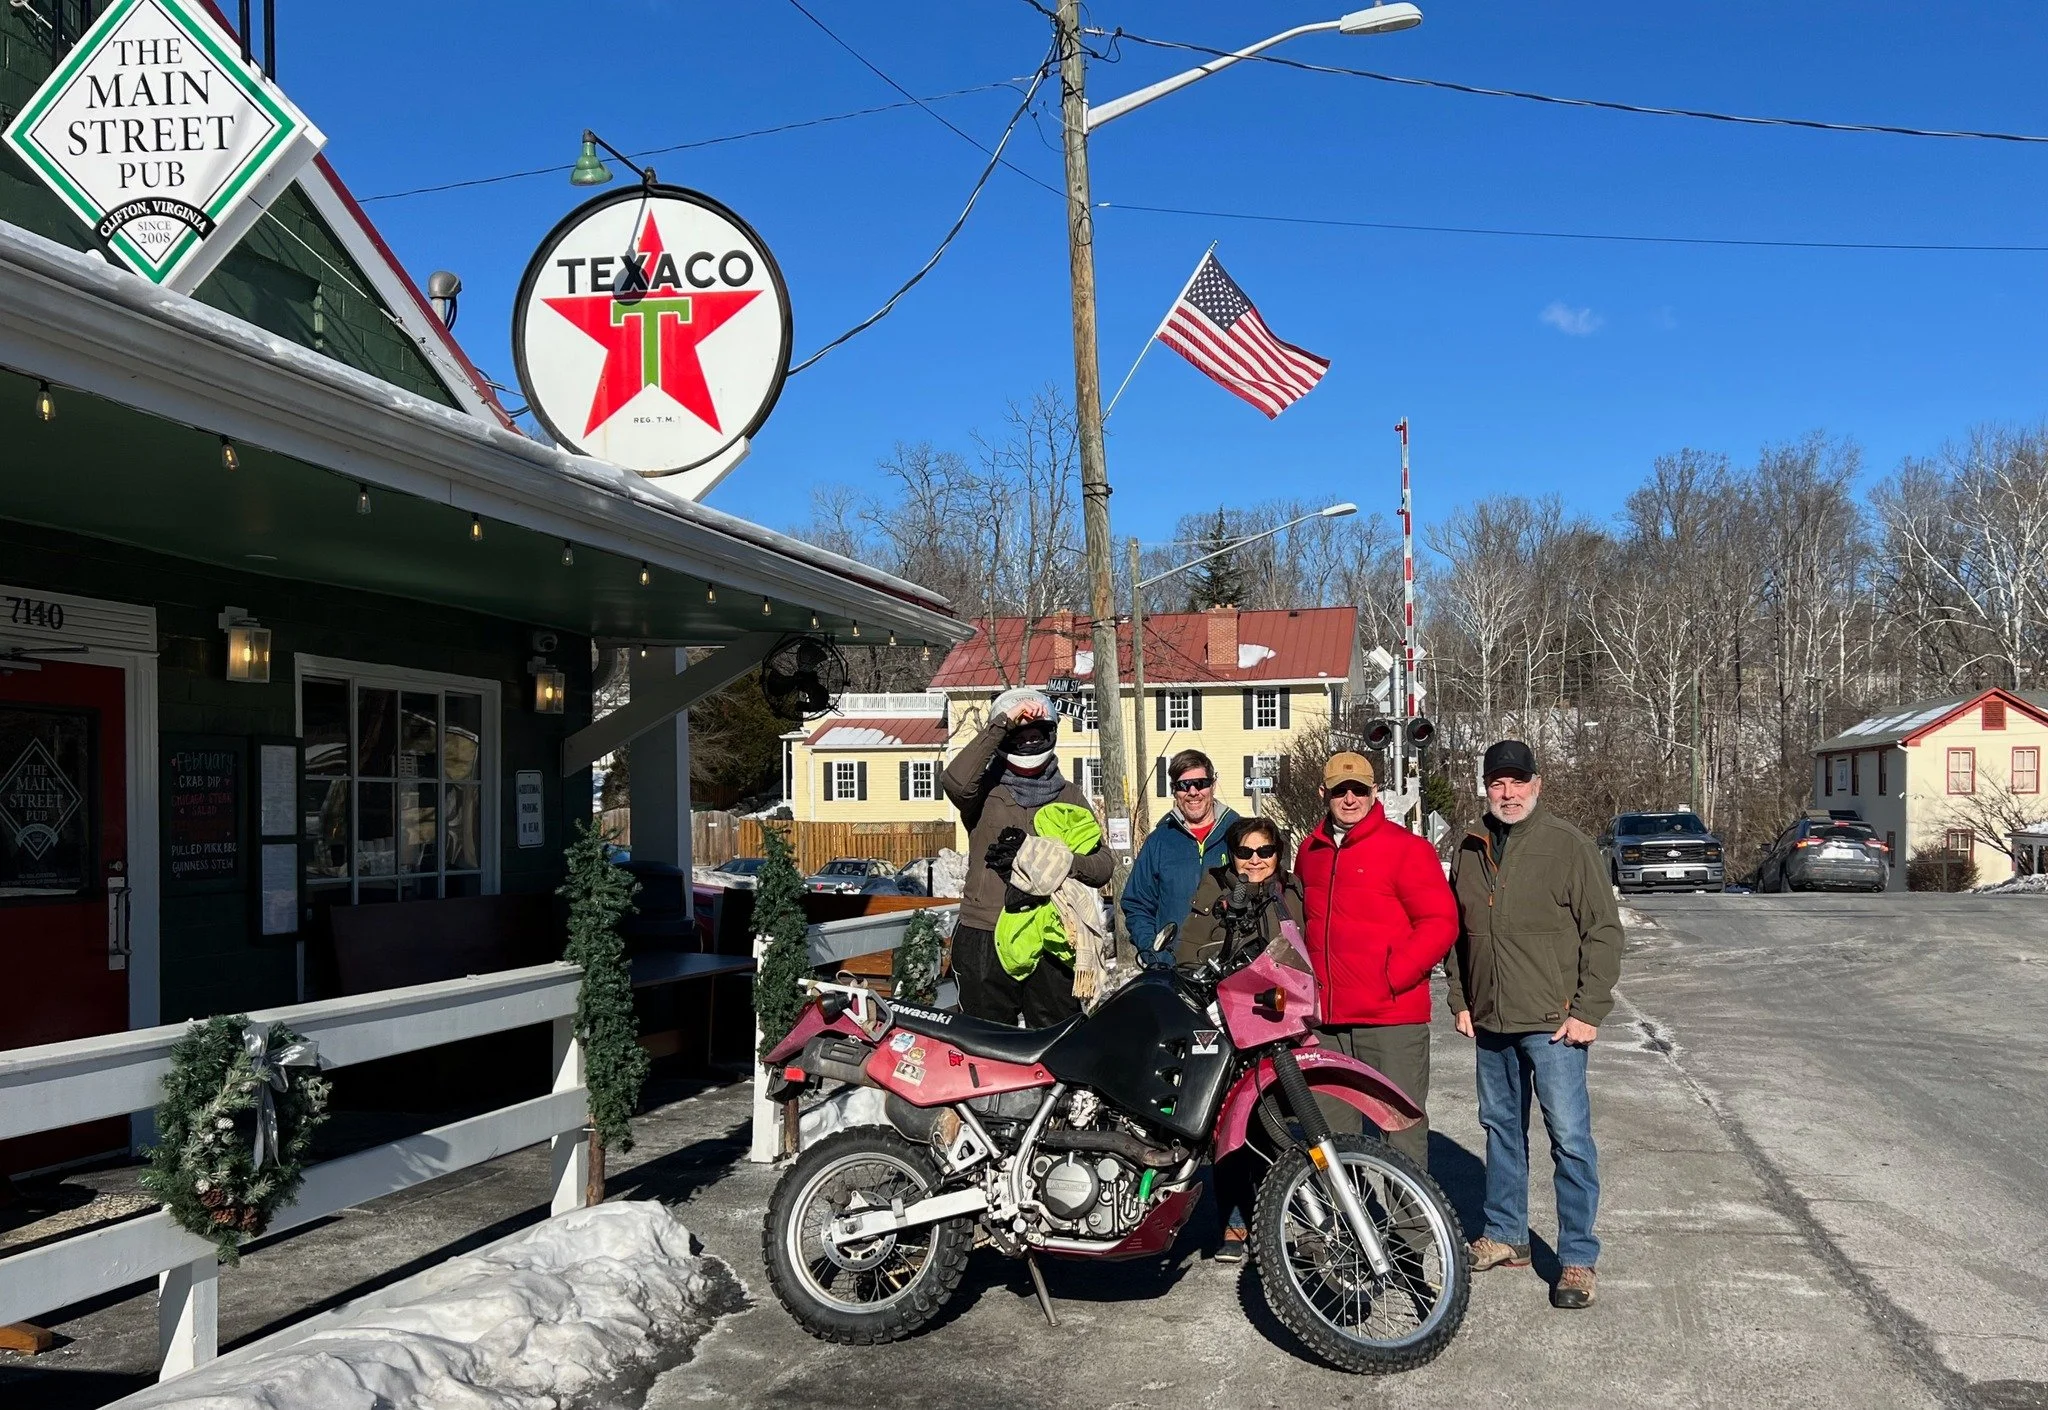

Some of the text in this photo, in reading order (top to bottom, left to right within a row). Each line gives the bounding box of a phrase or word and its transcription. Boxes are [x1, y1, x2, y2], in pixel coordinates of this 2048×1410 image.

[113, 37, 183, 66] THE
[86, 70, 213, 109] MAIN
[67, 115, 235, 156] STREET
[118, 160, 185, 189] PUB
[100, 201, 206, 237] CLIFTON, VIRGINIA
[138, 220, 171, 231] SINCE
[140, 232, 171, 244] 2008
[557, 250, 754, 294] TEXACO
[6, 597, 64, 630] 7140
[1049, 679, 1078, 691] MAIN ST
[1066, 703, 1081, 717] LN
[26, 764, 48, 776] THE
[177, 752, 233, 775] February
[15, 777, 56, 791] MAIN
[179, 775, 221, 788] CRAB DIP
[9, 793, 63, 808] STREET
[26, 810, 48, 821] PUB
[171, 844, 202, 857] PULLED
[172, 858, 233, 873] GUINNESS STEW
